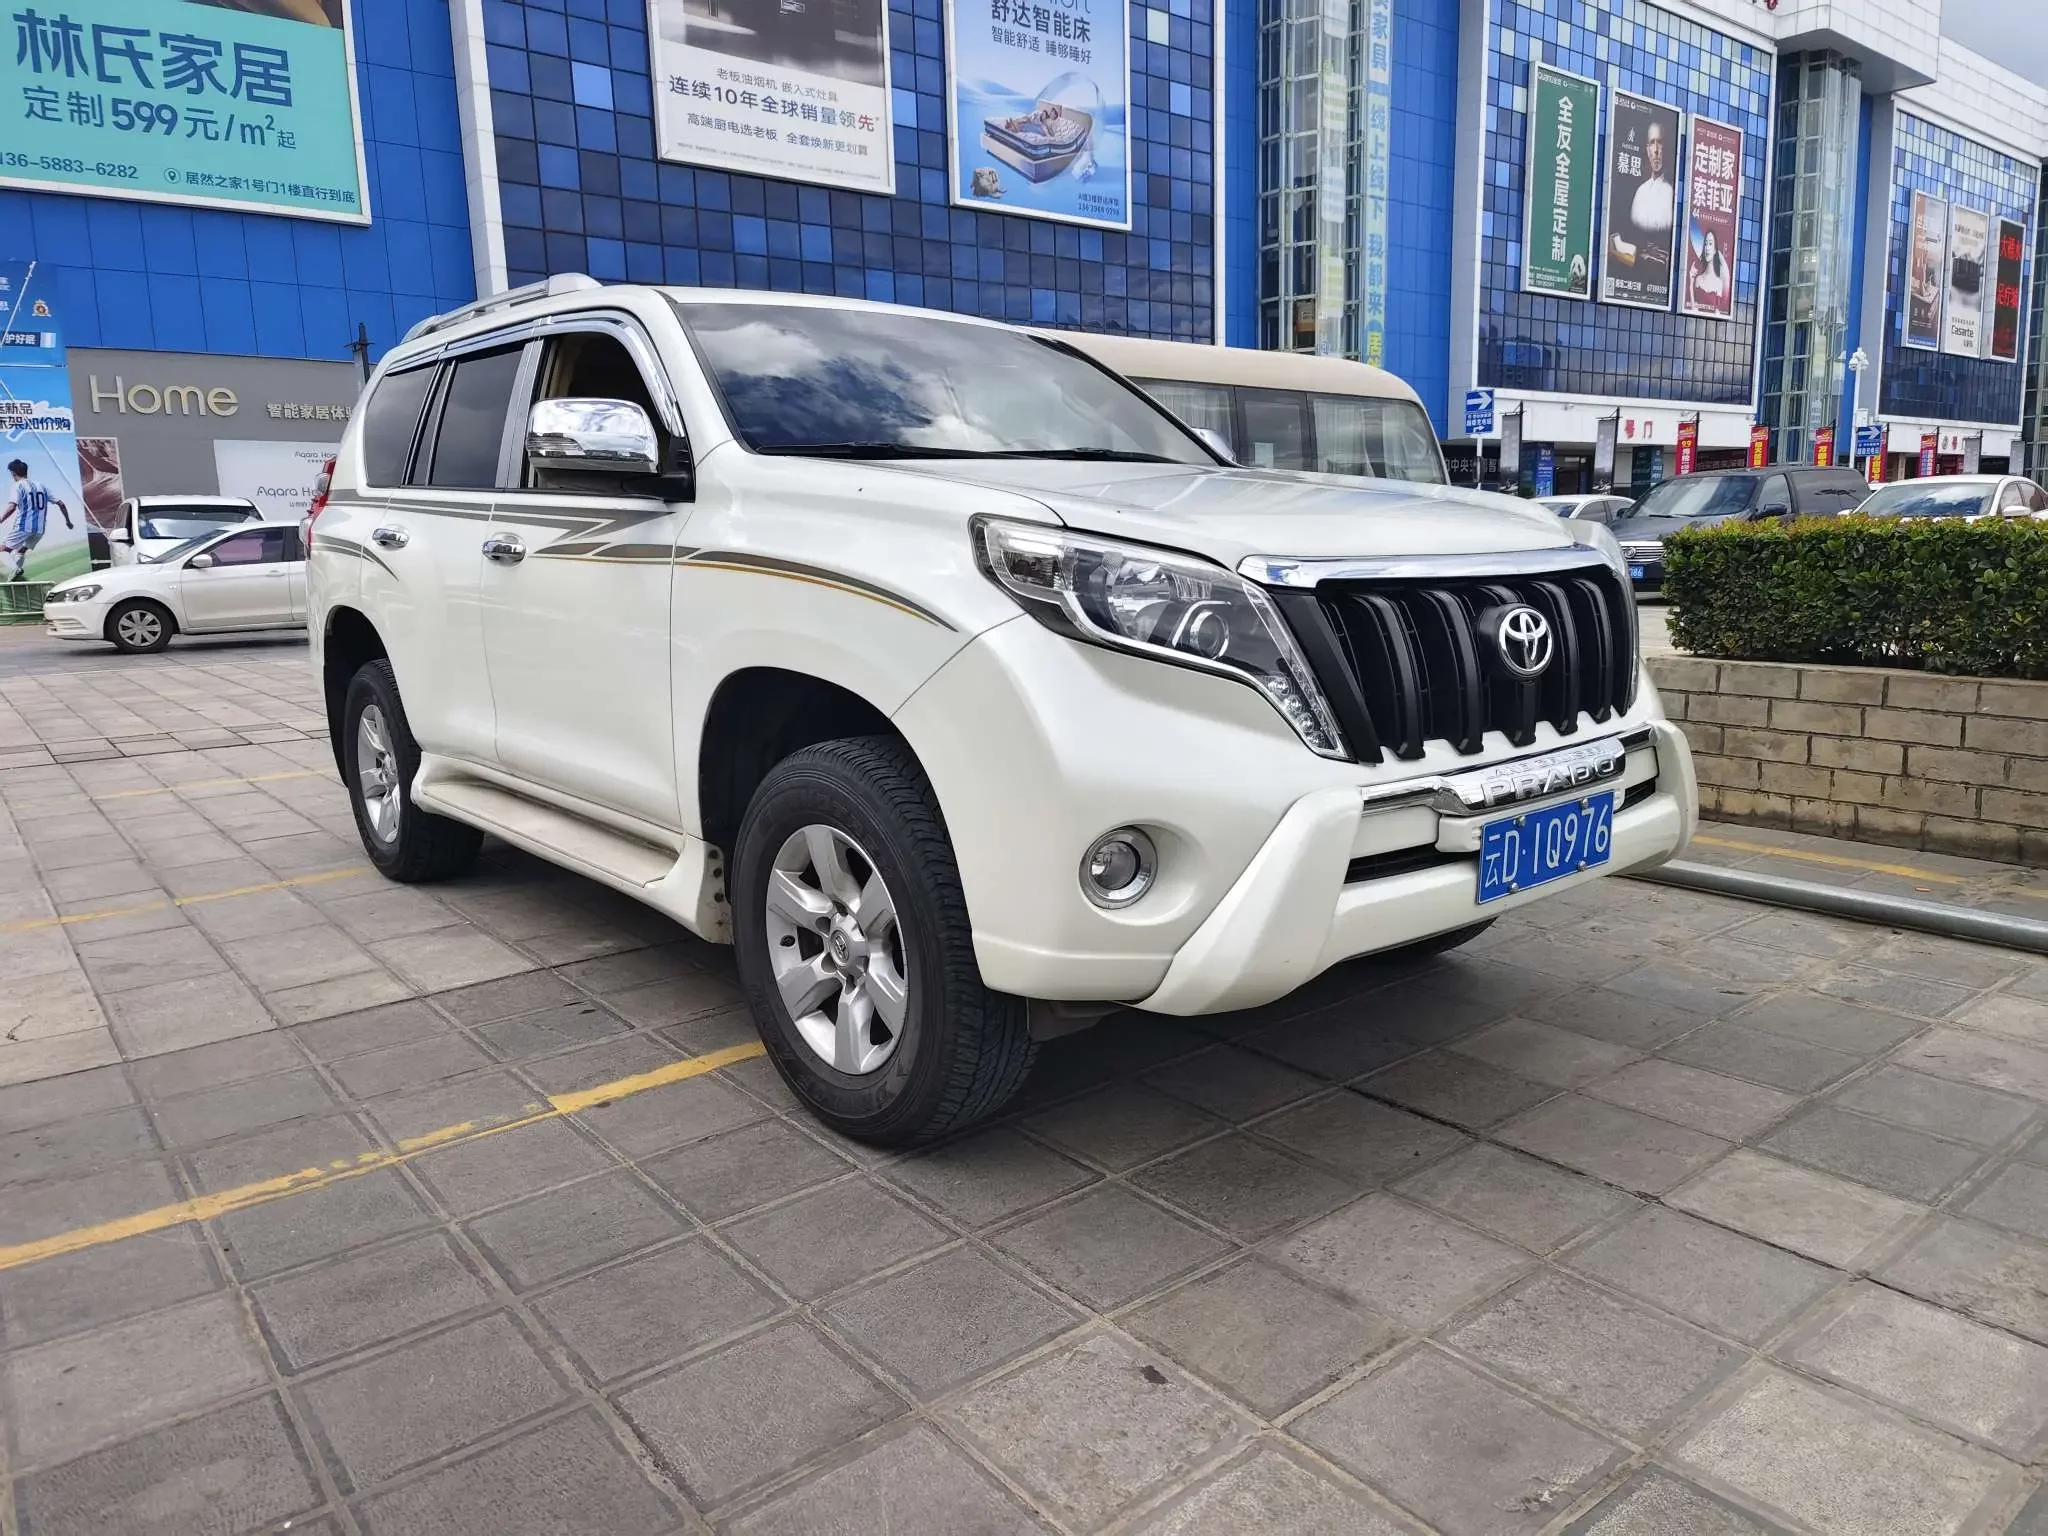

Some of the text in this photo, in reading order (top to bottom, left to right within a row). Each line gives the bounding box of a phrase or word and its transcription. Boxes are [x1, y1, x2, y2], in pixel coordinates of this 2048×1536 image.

[991, 0, 1091, 43] 舒达智能床
[13, 8, 293, 107] 林氏家居
[992, 25, 1092, 64] 智能舒适 睡够睡好
[717, 67, 778, 91] 老板油烟机
[687, 112, 778, 141] 高端厨电选老板
[1551, 96, 1573, 262] 全友全屋定制
[1694, 142, 1735, 180] 定制家
[185, 171, 356, 204] 居然之家1号门1楼直行到底
[1692, 176, 1733, 214] 索菲亚
[89, 374, 239, 417] Home
[29, 492, 46, 511] 10
[257, 486, 298, 499] Aqara
[1481, 758, 1615, 805] PRADO
